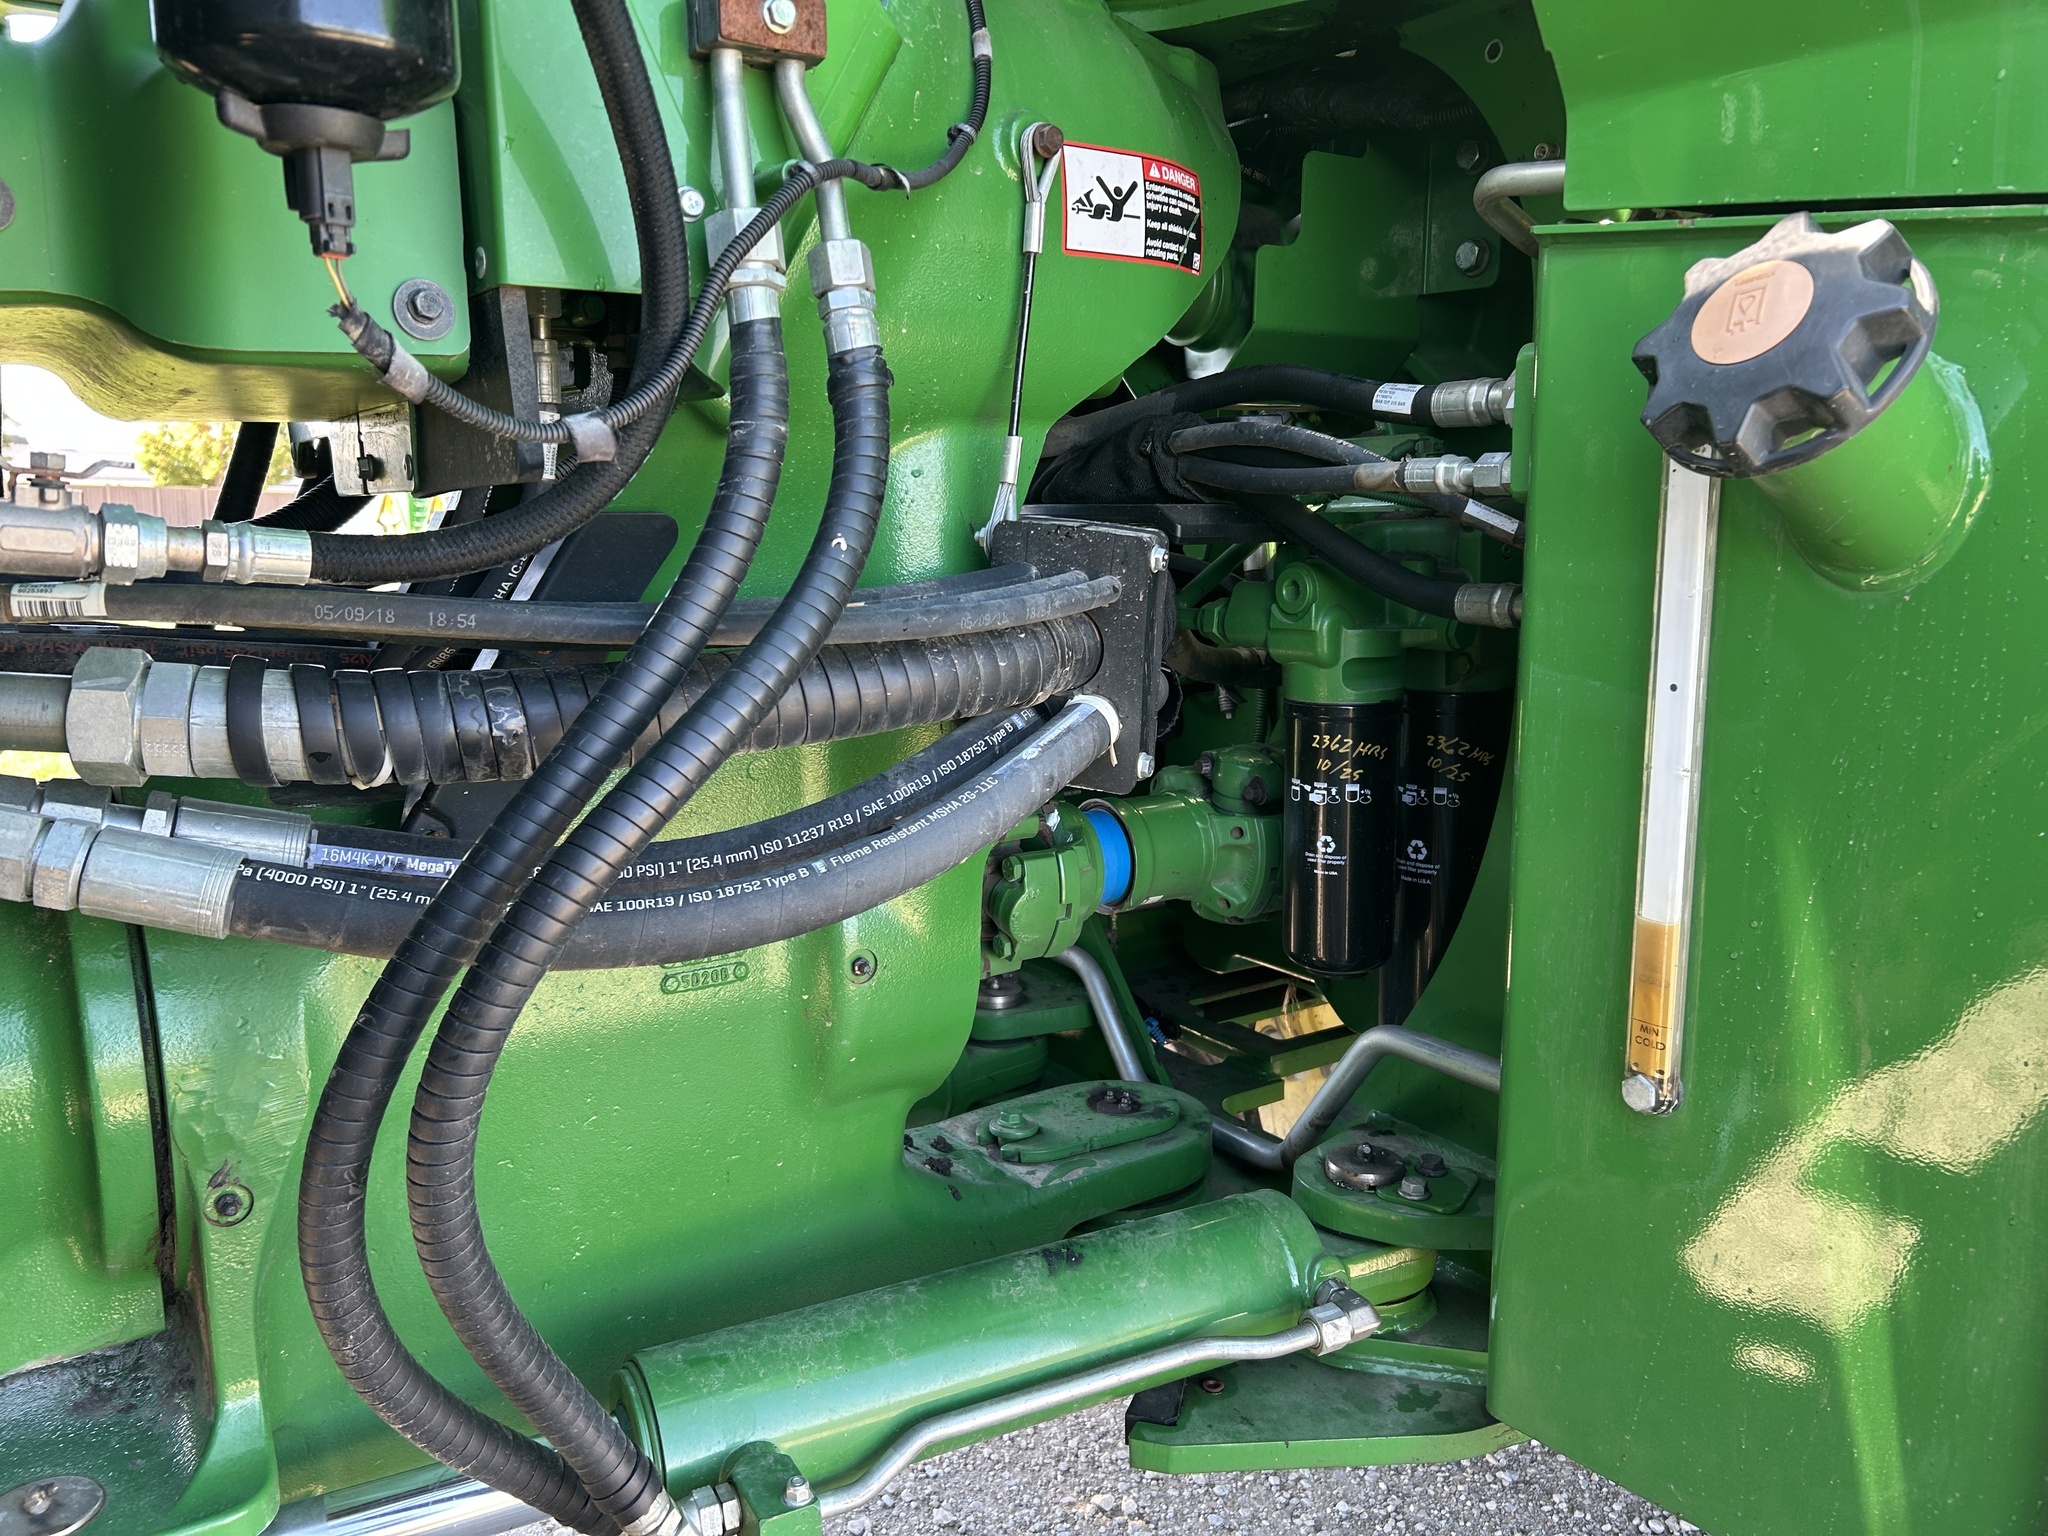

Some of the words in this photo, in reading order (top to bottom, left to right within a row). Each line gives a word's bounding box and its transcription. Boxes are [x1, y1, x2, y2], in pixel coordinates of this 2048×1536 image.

[1161, 165, 1196, 191] DANGER
[1146, 191, 1169, 204] driveline
[1169, 197, 1177, 205] can
[1162, 205, 1169, 213] or
[1146, 219, 1161, 231] Keep
[1146, 238, 1162, 248] Avoid
[1162, 241, 1179, 252] contact
[1146, 248, 1166, 260] rotating
[492, 581, 513, 600] HA
[314, 604, 396, 624] 05/09/18
[428, 611, 477, 629] 18:54
[1311, 734, 1353, 754] 2362
[1352, 741, 1389, 760] HRS
[1427, 735, 1471, 756] 2362
[1467, 746, 1495, 766] HRS
[1316, 758, 1364, 781] 10/25
[1427, 756, 1471, 782] 10/25
[686, 853, 723, 874] (25.4
[725, 845, 758, 864] mm)
[760, 839, 783, 855] ISO
[784, 824, 826, 849] 11237
[827, 813, 854, 833] R19
[855, 809, 861, 822] /
[863, 798, 887, 818] SAE
[886, 774, 932, 805] 100R19
[932, 769, 938, 783] /
[937, 760, 957, 778] ISO
[955, 739, 987, 766] 18752
[984, 728, 1008, 746] Type
[1004, 722, 1014, 733] B
[616, 896, 674, 911] 100R19
[678, 894, 684, 907] /
[689, 890, 713, 904] ISO
[715, 880, 762, 899] 18752
[763, 873, 797, 888] Type
[798, 867, 810, 879] B
[829, 843, 872, 867] Flame
[871, 818, 930, 850] Resistant
[929, 801, 963, 822] MSHA
[958, 775, 999, 804] 2G-11C
[1415, 861, 1434, 869] dispose
[1417, 867, 1438, 876] properly
[255, 867, 307, 886] (4000
[310, 877, 345, 895] PSI)
[369, 886, 412, 902] (25.4
[1400, 874, 1413, 882] Made
[1639, 1024, 1659, 1037] MIN
[1634, 1035, 1666, 1051] COLD
